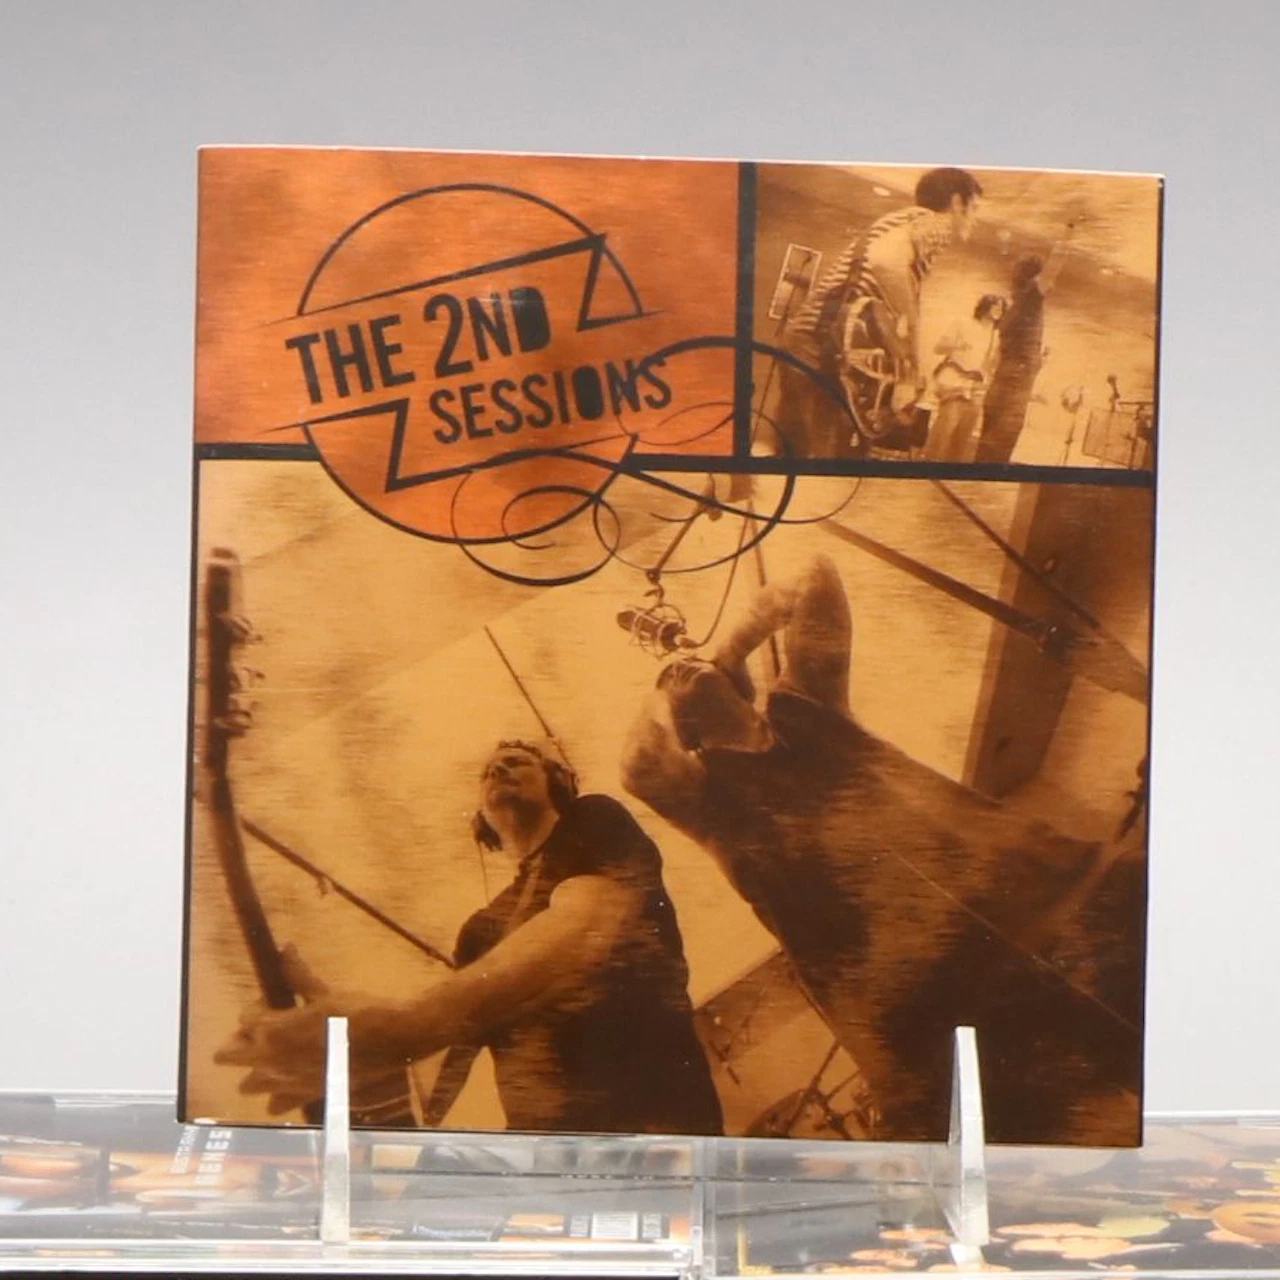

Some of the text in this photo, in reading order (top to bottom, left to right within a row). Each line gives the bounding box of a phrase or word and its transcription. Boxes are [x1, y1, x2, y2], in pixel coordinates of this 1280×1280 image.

[285, 286, 552, 402] THE 2ND
[431, 357, 673, 443] SESSIONS
